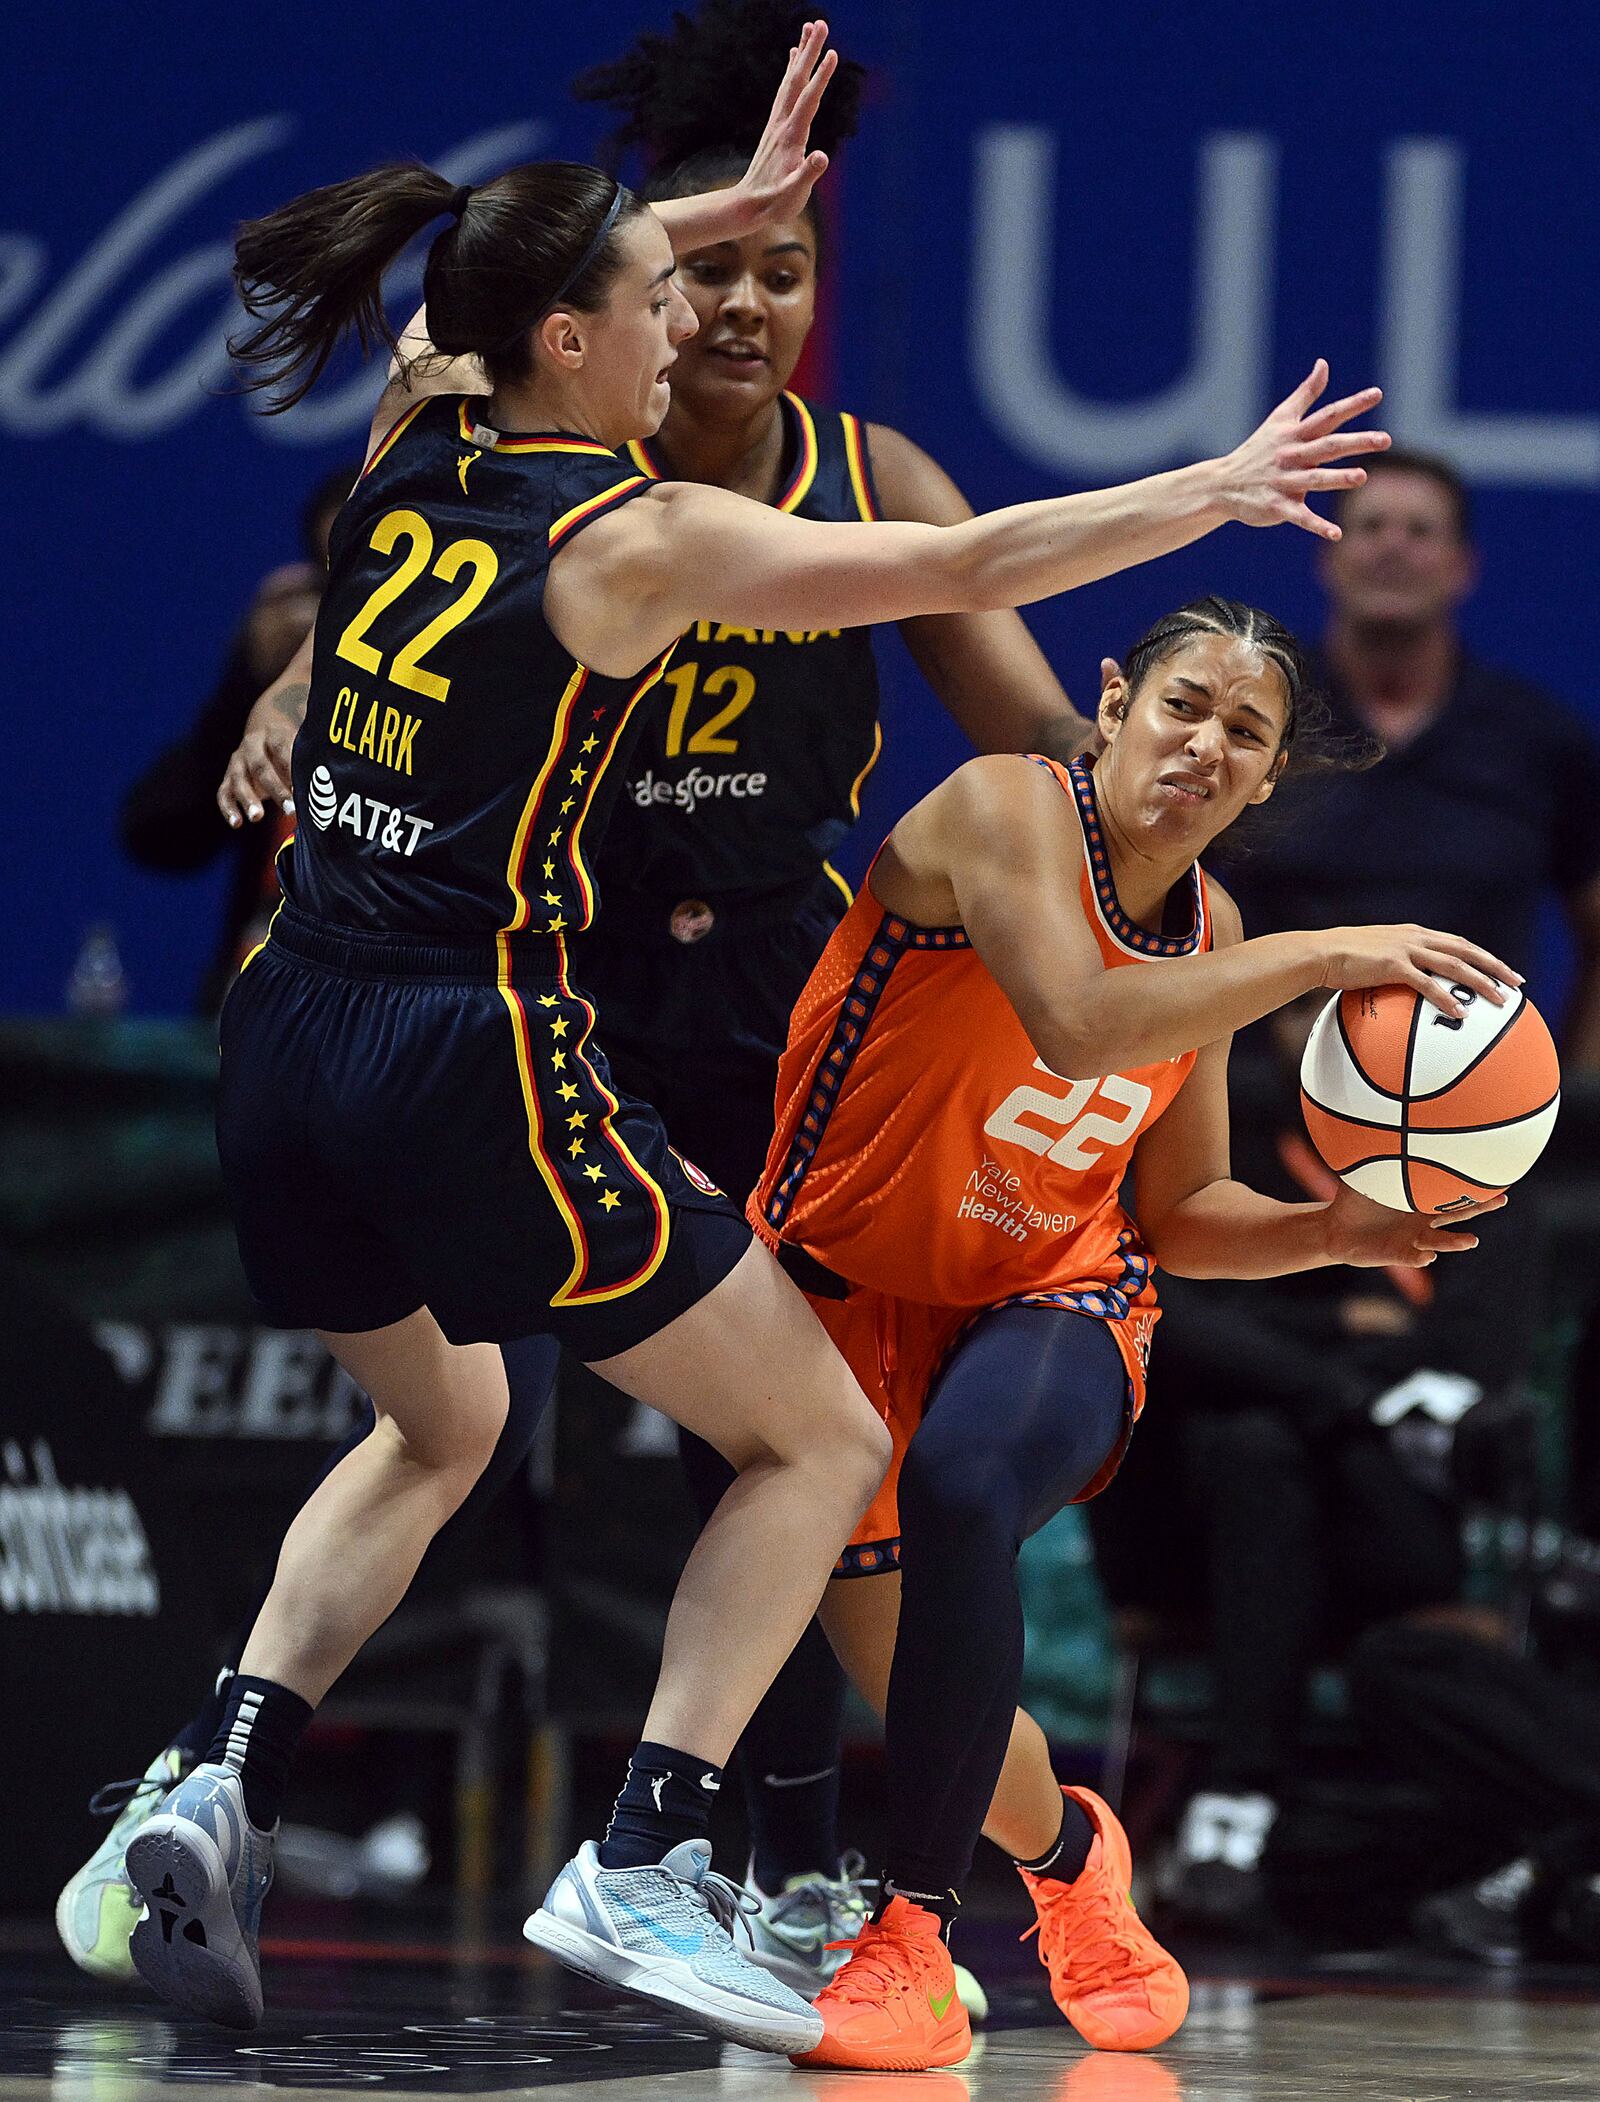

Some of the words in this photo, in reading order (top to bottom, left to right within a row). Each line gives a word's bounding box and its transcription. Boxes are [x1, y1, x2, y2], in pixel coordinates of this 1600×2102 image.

[336, 509, 499, 703] 22
[329, 686, 422, 776] CLARK
[664, 661, 757, 758] 12
[338, 792, 434, 857] AT&T
[983, 1056, 1152, 1171] 22
[981, 1154, 1021, 1192] Yale
[957, 1195, 1028, 1242] Health
